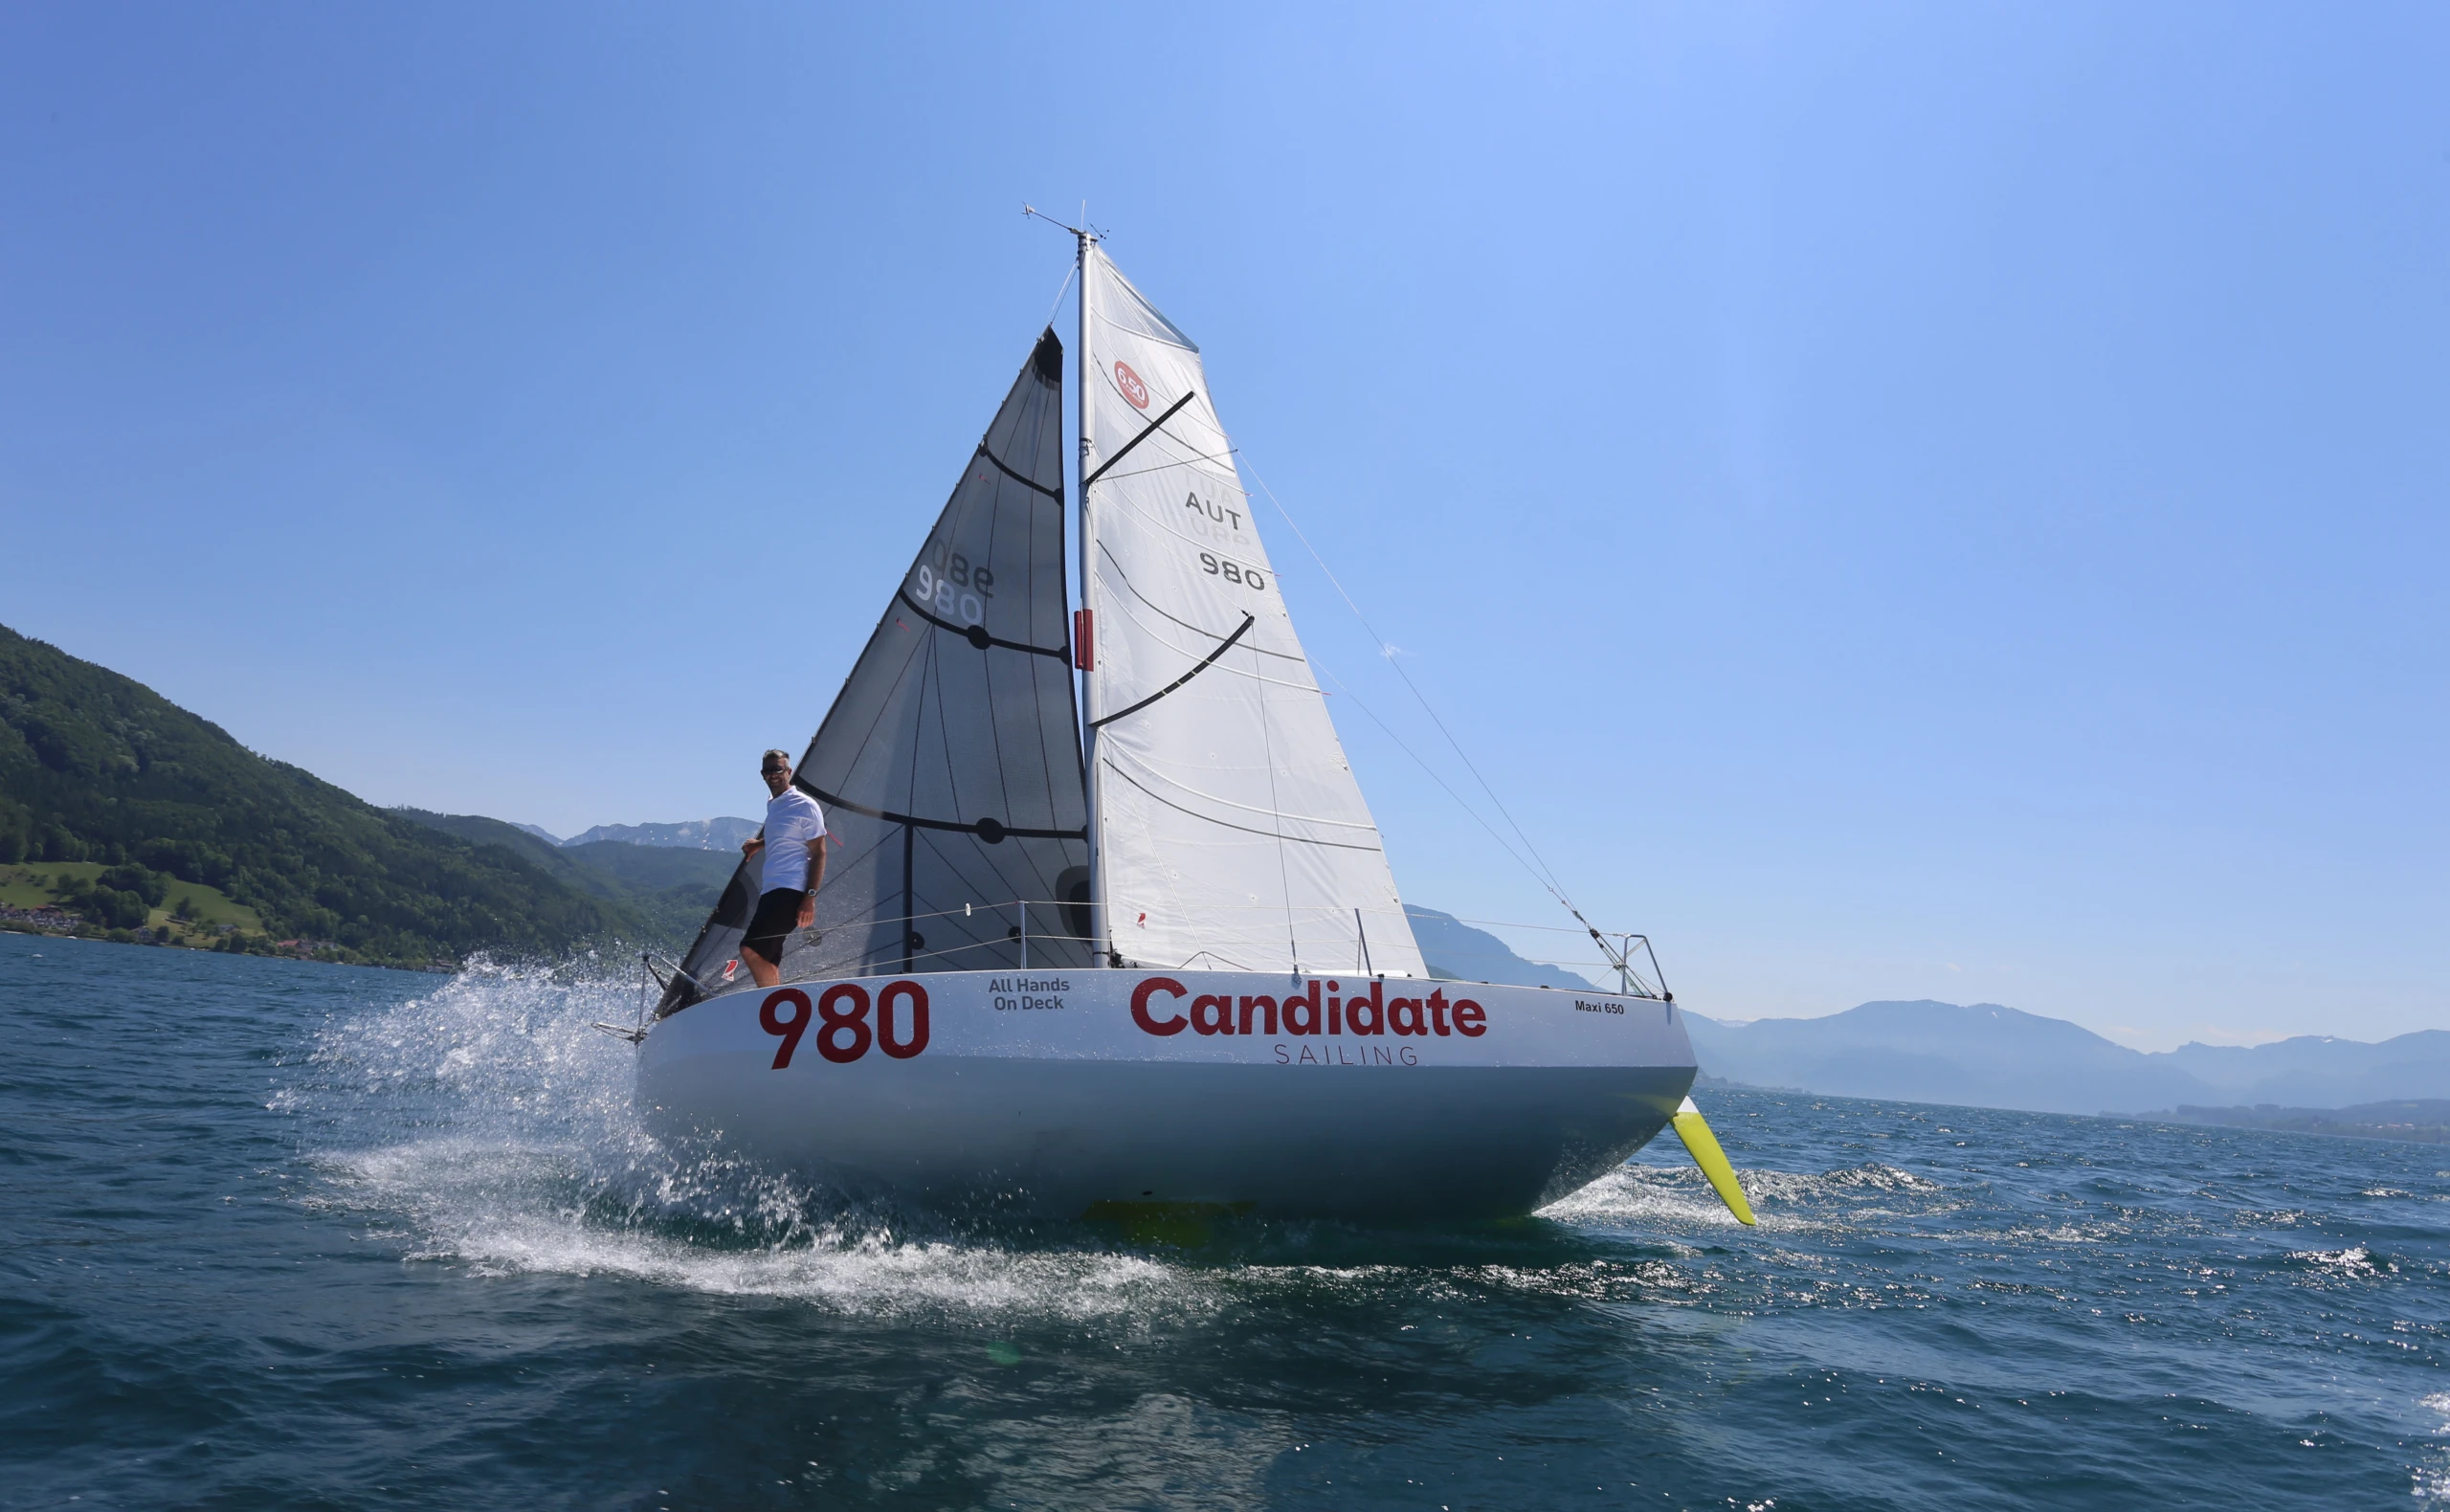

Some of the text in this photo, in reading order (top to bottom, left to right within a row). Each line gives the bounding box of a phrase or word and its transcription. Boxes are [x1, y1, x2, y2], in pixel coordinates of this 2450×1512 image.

[1185, 491, 1241, 530] AUT
[1199, 552, 1265, 590] 980
[916, 565, 982, 625] 980
[989, 977, 1070, 993] All Hands
[993, 995, 1064, 1011] On Deck
[759, 980, 929, 1070] 980
[1130, 976, 1487, 1037] Candidate
[1574, 1000, 1625, 1015] Maxi 650
[1275, 1043, 1418, 1066] SAILING
